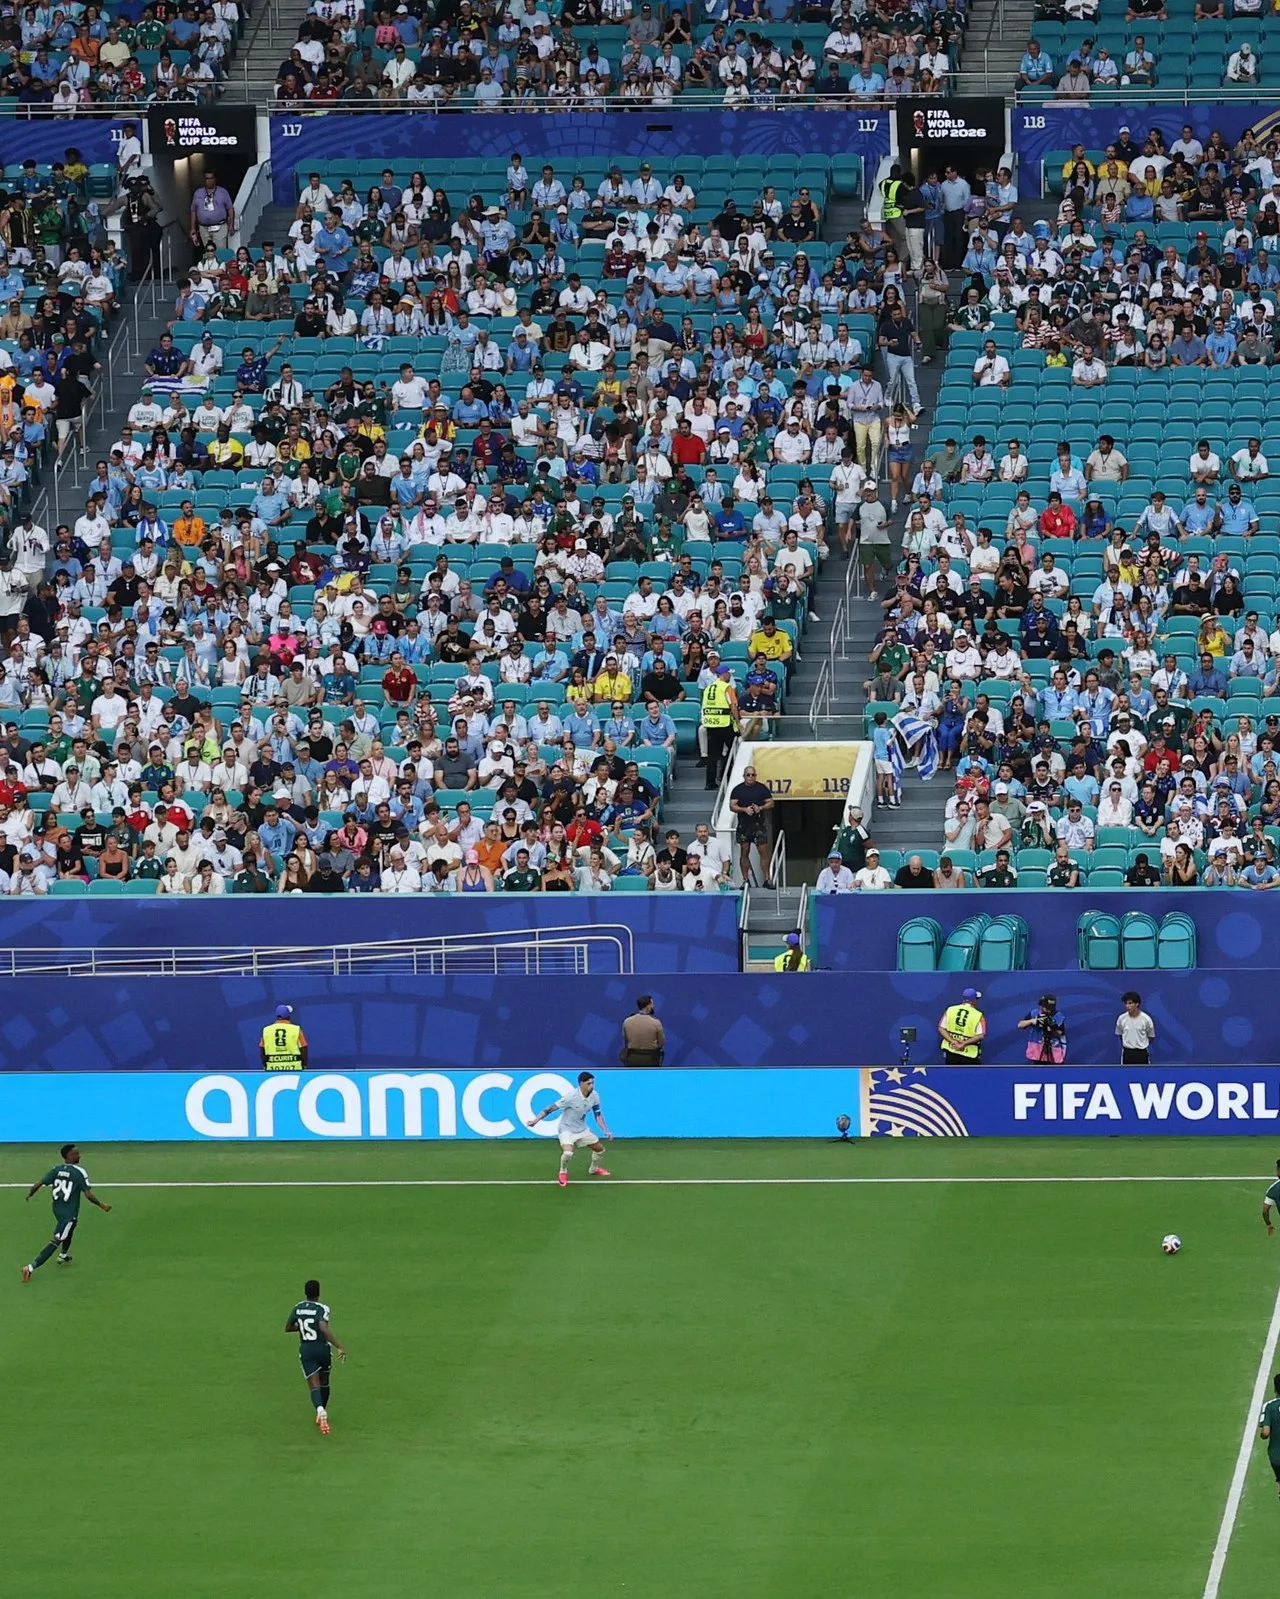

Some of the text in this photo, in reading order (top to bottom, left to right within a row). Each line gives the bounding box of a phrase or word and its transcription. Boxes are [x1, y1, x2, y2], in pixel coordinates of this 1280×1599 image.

[927, 110, 949, 118] FIFA
[179, 118, 201, 126] FIFA
[858, 119, 878, 132] 117
[927, 119, 965, 128] WORLD
[1023, 116, 1046, 129] 118
[179, 127, 216, 136] WORLD
[282, 124, 303, 136] 117
[927, 129, 987, 138] CUP 2026
[179, 136, 238, 146] CUP 2026
[767, 778, 850, 794] 117 118
[185, 1073, 578, 1138] aramco
[1014, 1083, 1122, 1120] FIFA
[53, 1178, 73, 1202] 24
[297, 1318, 318, 1341] 15
